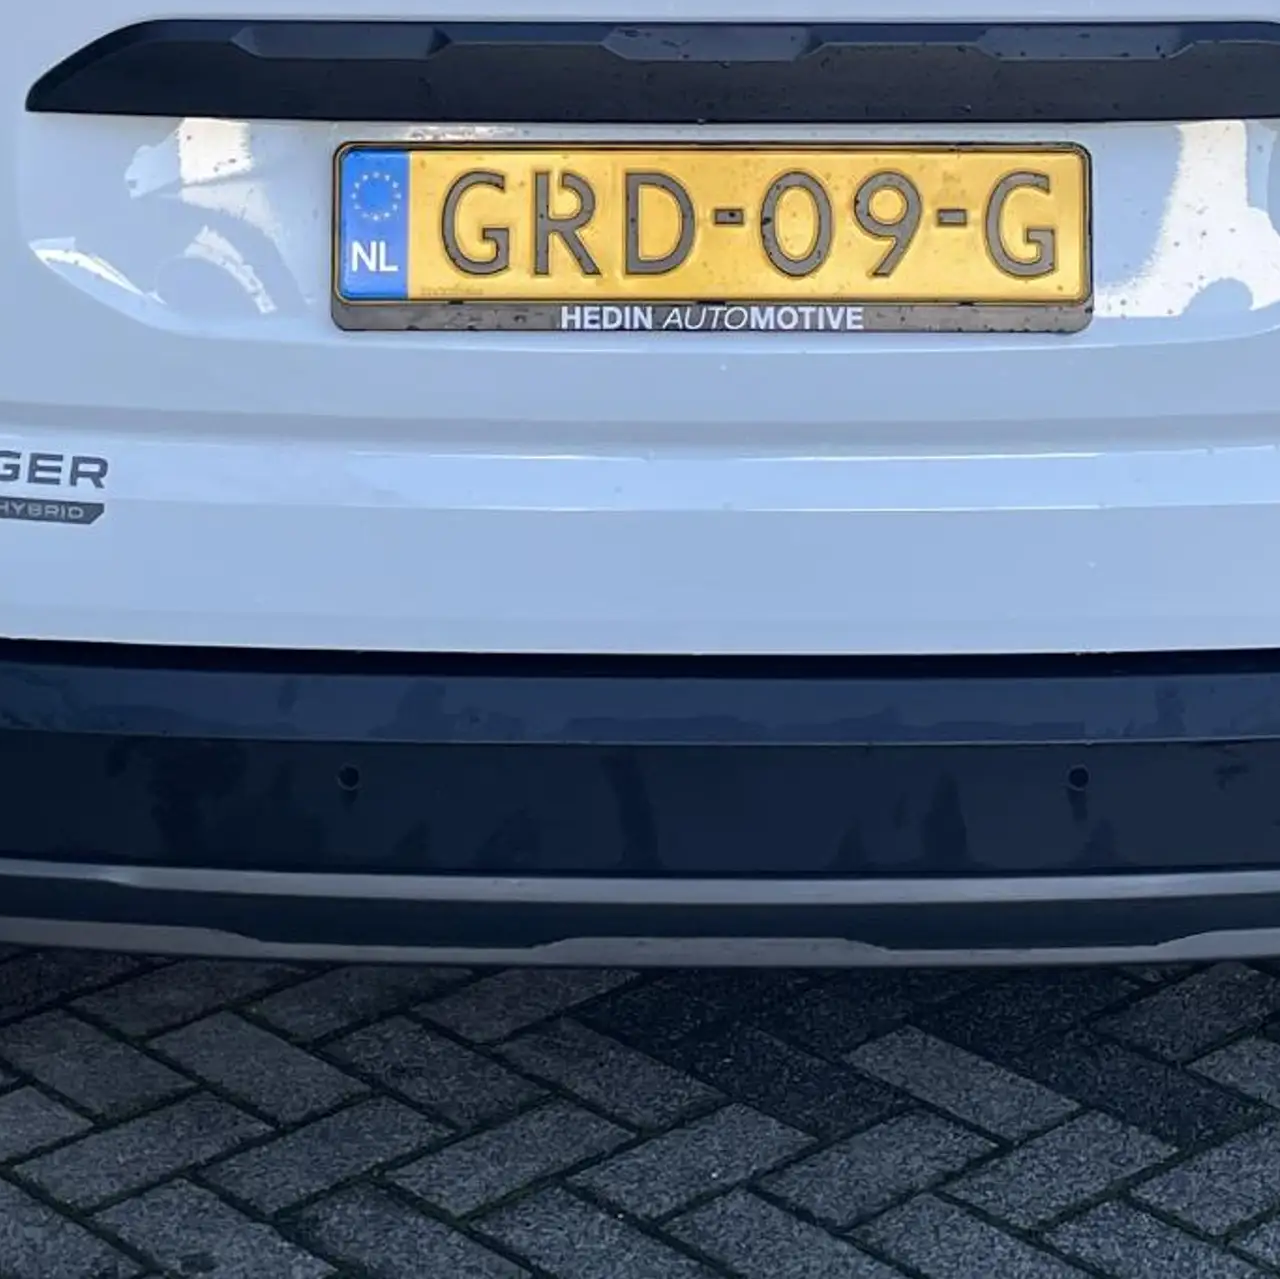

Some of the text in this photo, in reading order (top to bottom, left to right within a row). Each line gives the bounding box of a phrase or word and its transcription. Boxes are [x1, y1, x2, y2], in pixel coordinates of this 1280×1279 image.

[440, 170, 1059, 279] GRD-09-G
[350, 240, 400, 273] NL
[560, 305, 865, 330] HEDIN AUTOMOTIVE
